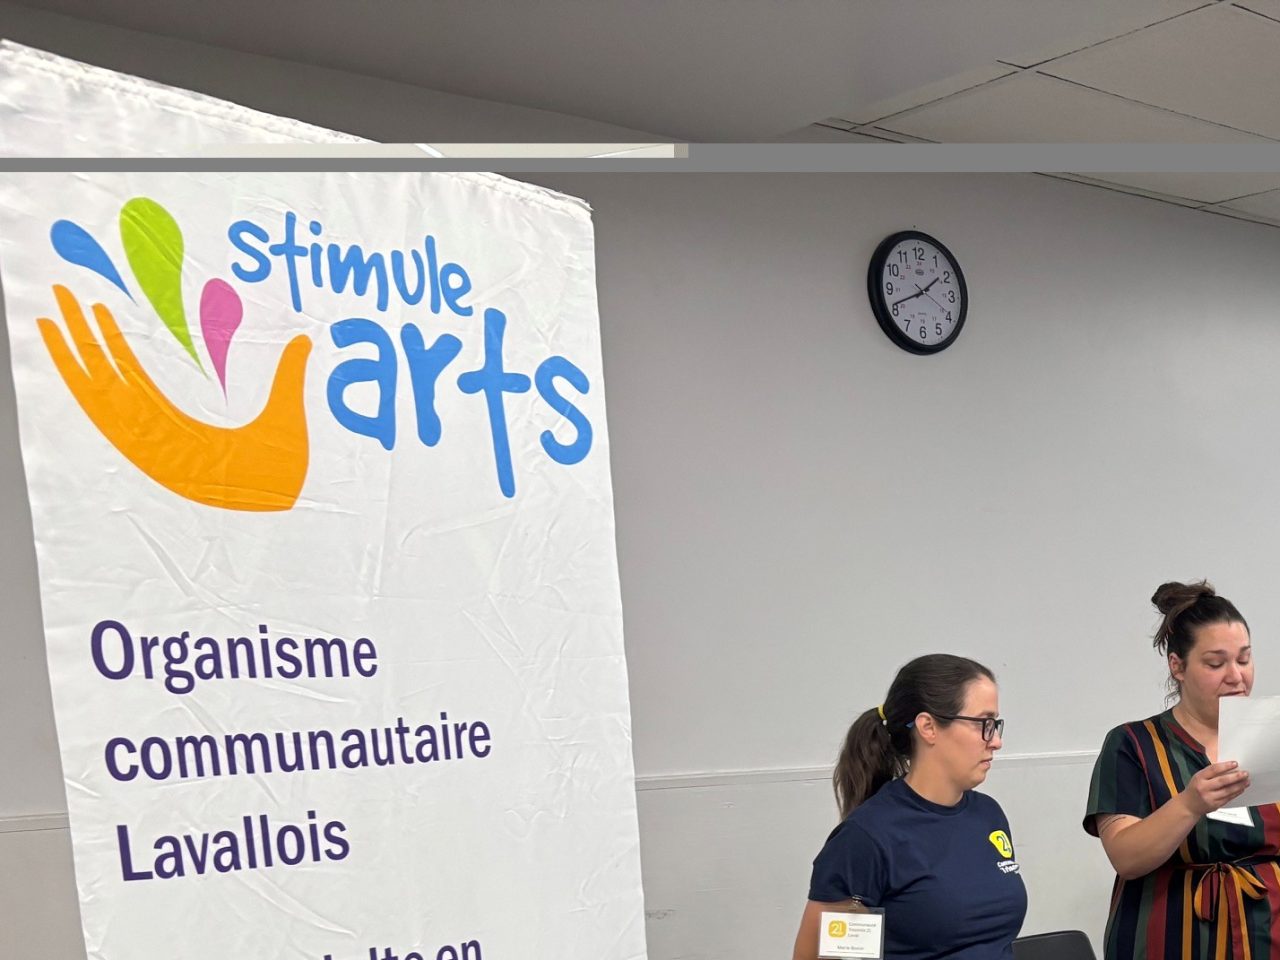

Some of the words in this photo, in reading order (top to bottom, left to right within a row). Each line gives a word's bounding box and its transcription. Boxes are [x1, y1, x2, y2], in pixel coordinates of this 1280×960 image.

[897, 250, 908, 264] 11
[912, 247, 925, 261] 12
[228, 212, 474, 316] stimule
[933, 255, 938, 268] 1
[887, 263, 899, 277] 10
[943, 271, 950, 283] 2
[886, 282, 894, 295] 9
[948, 290, 955, 303] 3
[892, 303, 899, 317] 8
[946, 311, 952, 323] 4
[904, 319, 911, 332] 7
[920, 326, 927, 339] 6
[936, 323, 942, 336] 5
[327, 309, 594, 498] arts
[90, 619, 378, 694] Organisme
[104, 712, 491, 781] communautaire
[116, 810, 350, 882] Lavallois
